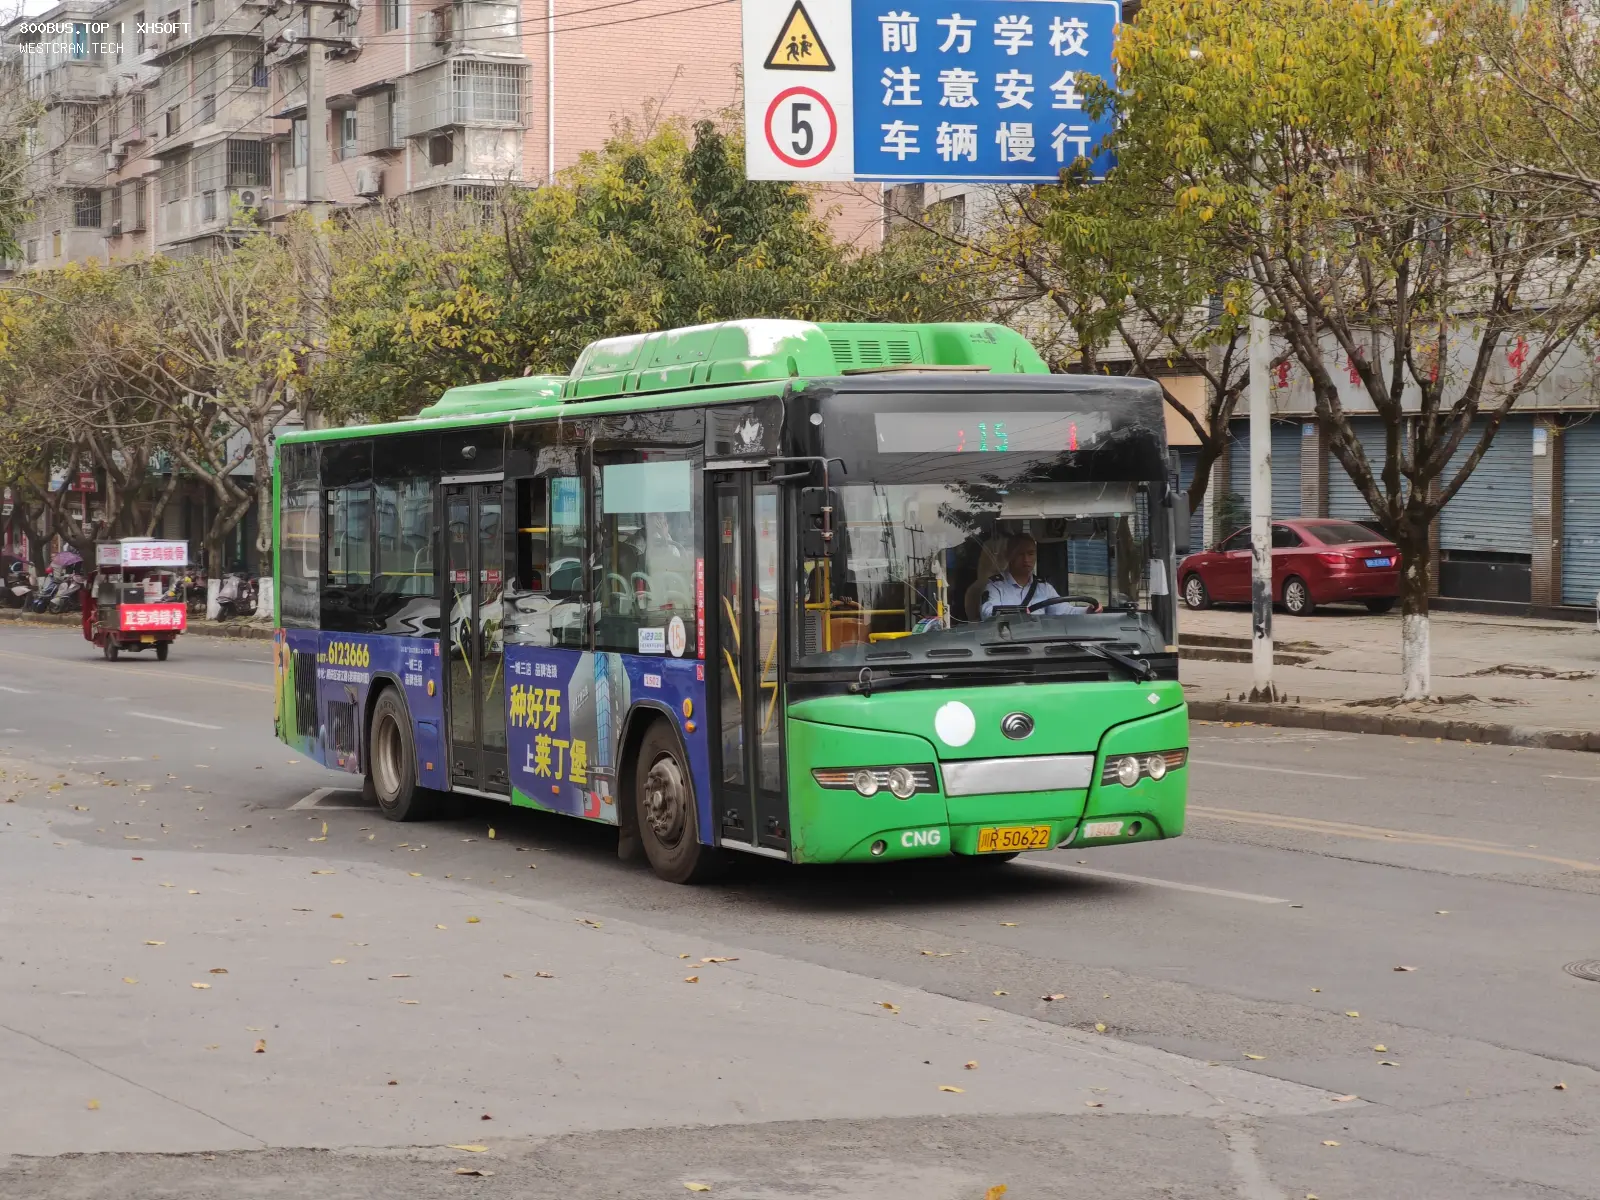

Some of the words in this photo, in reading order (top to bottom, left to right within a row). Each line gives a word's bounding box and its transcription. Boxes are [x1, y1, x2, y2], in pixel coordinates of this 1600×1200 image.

[877, 11, 1089, 57] 前方学校
[880, 66, 1084, 110] 注意安全
[791, 102, 814, 156] 5
[880, 119, 1092, 162] 车辆慢行
[509, 684, 561, 732] 种好牙
[901, 830, 941, 848] CNG
